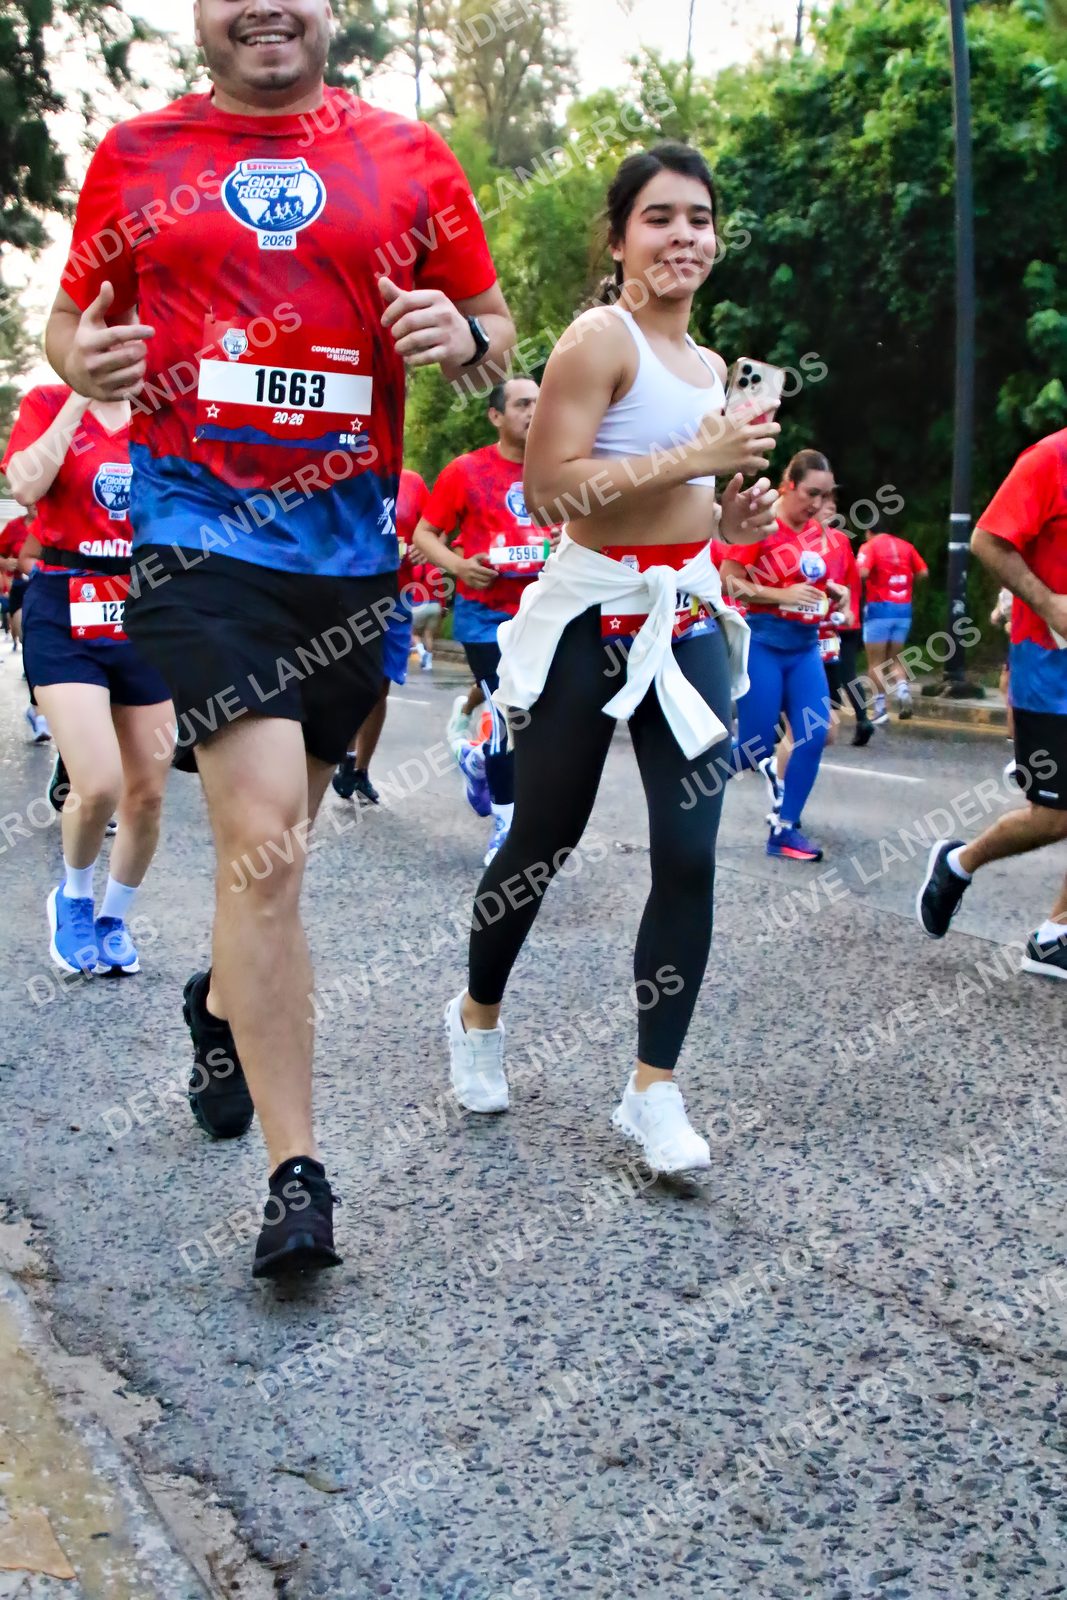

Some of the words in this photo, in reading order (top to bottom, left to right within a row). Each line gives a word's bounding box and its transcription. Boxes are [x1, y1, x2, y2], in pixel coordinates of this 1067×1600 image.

[248, 173, 298, 189] Global
[237, 185, 280, 198] Race
[262, 235, 293, 246] 2026
[255, 368, 326, 408] 1663
[508, 546, 538, 561] 2596
